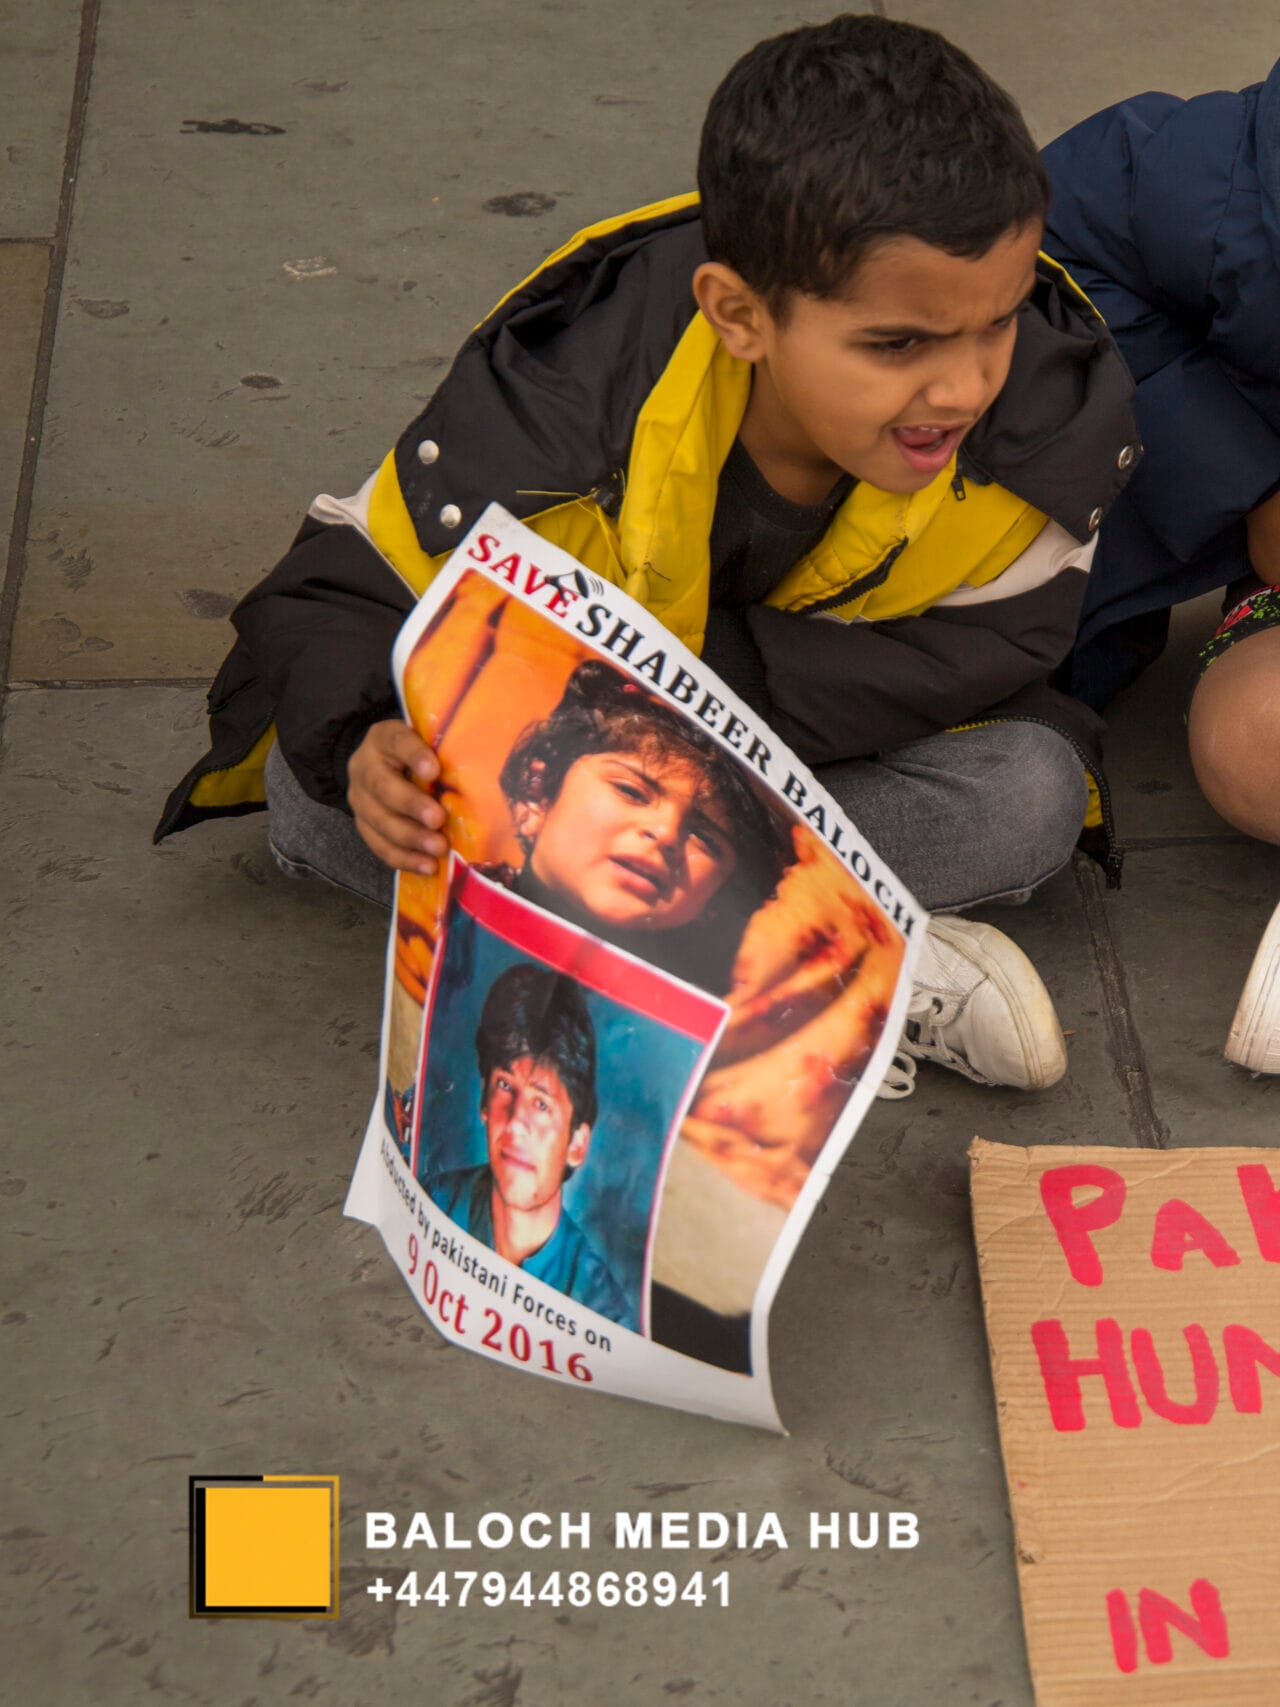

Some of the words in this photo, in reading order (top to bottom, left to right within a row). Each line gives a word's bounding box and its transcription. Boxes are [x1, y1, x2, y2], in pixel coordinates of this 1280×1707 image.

[467, 534, 579, 618] SAVE
[576, 603, 772, 776] SHABEER
[781, 770, 916, 938] BALOCH
[408, 1233, 418, 1275] 9
[423, 1260, 469, 1335] Oct
[481, 1307, 593, 1382] 2016
[418, 1202, 430, 1239] by
[431, 1227, 508, 1297] pakistani
[512, 1284, 577, 1337] Forces
[585, 1331, 612, 1352] on
[1107, 1578, 1230, 1673] IN
